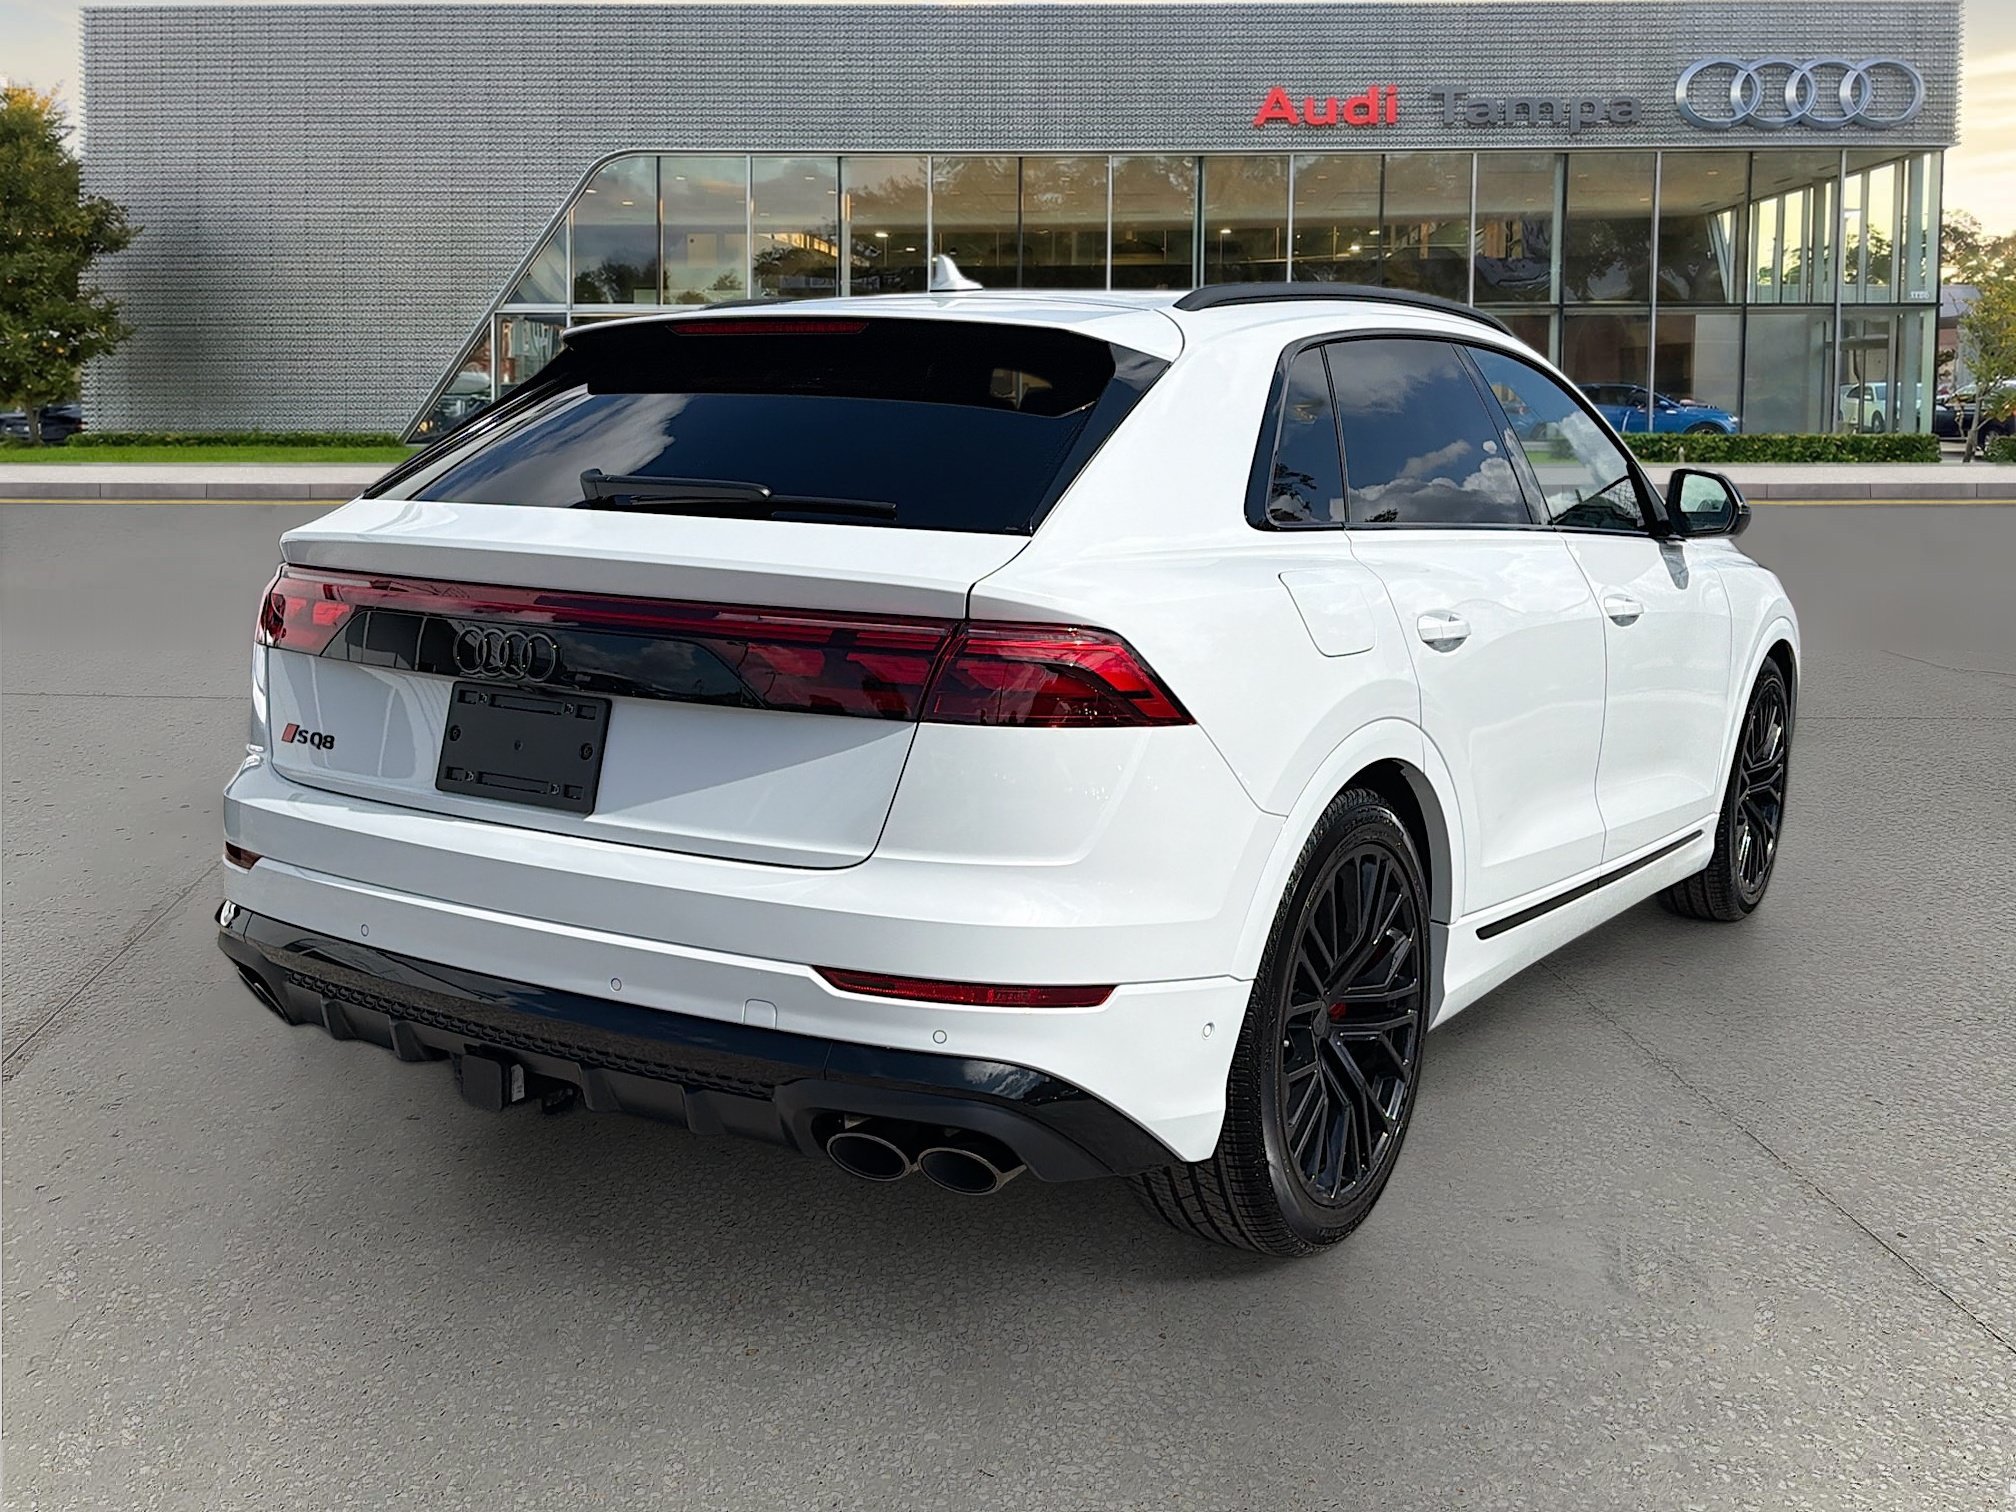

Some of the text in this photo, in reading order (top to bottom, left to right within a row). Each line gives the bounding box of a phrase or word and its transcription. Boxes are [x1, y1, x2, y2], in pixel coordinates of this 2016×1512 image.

[1253, 85, 1643, 134] Audi Tampa
[296, 729, 336, 750] SQ8
